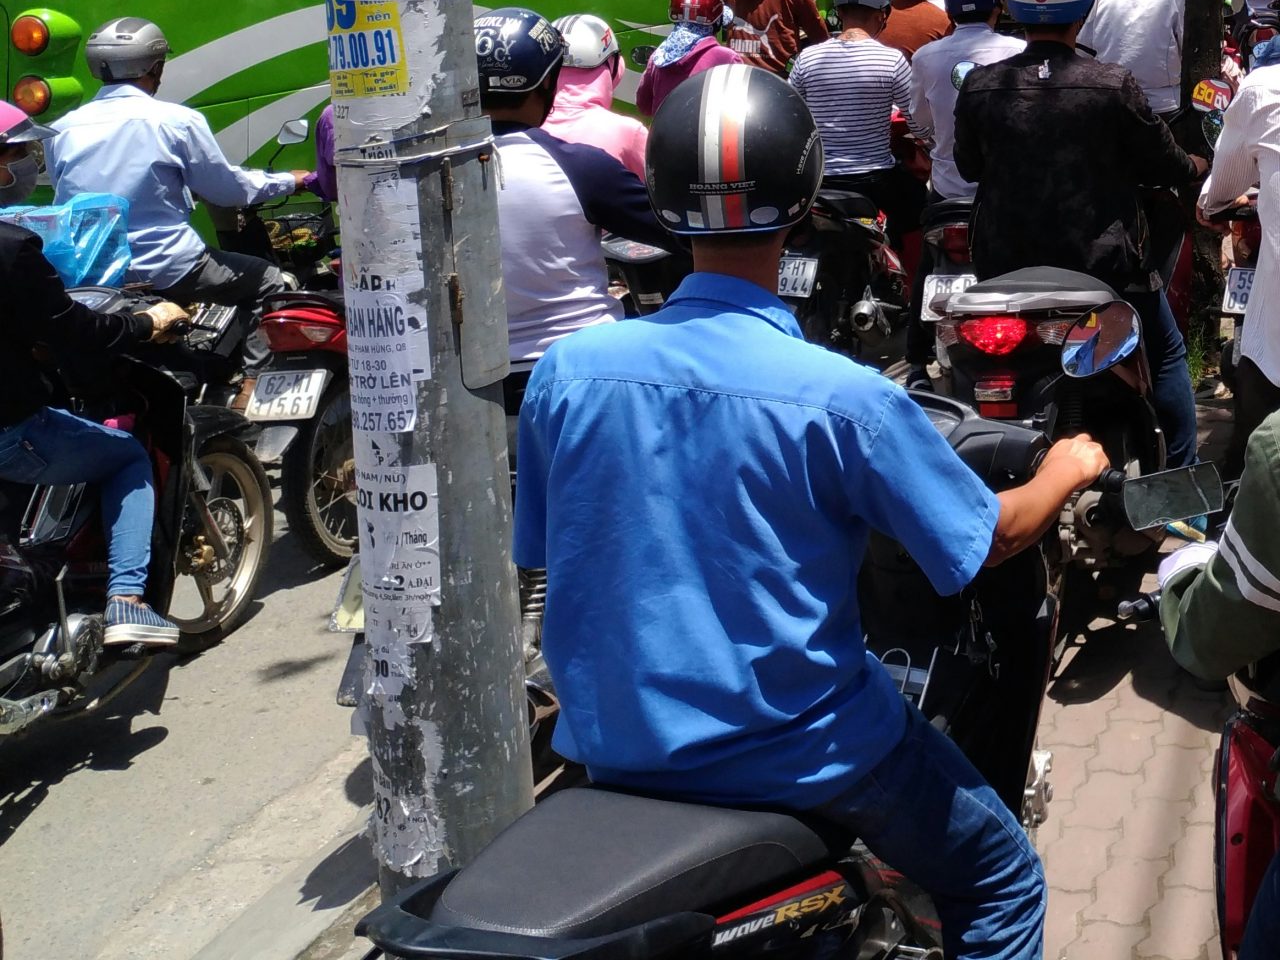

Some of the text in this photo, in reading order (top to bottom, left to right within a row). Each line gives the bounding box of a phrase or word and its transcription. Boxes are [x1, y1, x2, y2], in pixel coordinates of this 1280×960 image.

[505, 77, 522, 85] VIA
[730, 180, 757, 189] VIET
[367, 299, 406, 339] HÀNG
[361, 360, 387, 371] 18-30
[381, 371, 412, 390] LÊN
[379, 491, 428, 512] KHO
[774, 884, 846, 925] RSX
